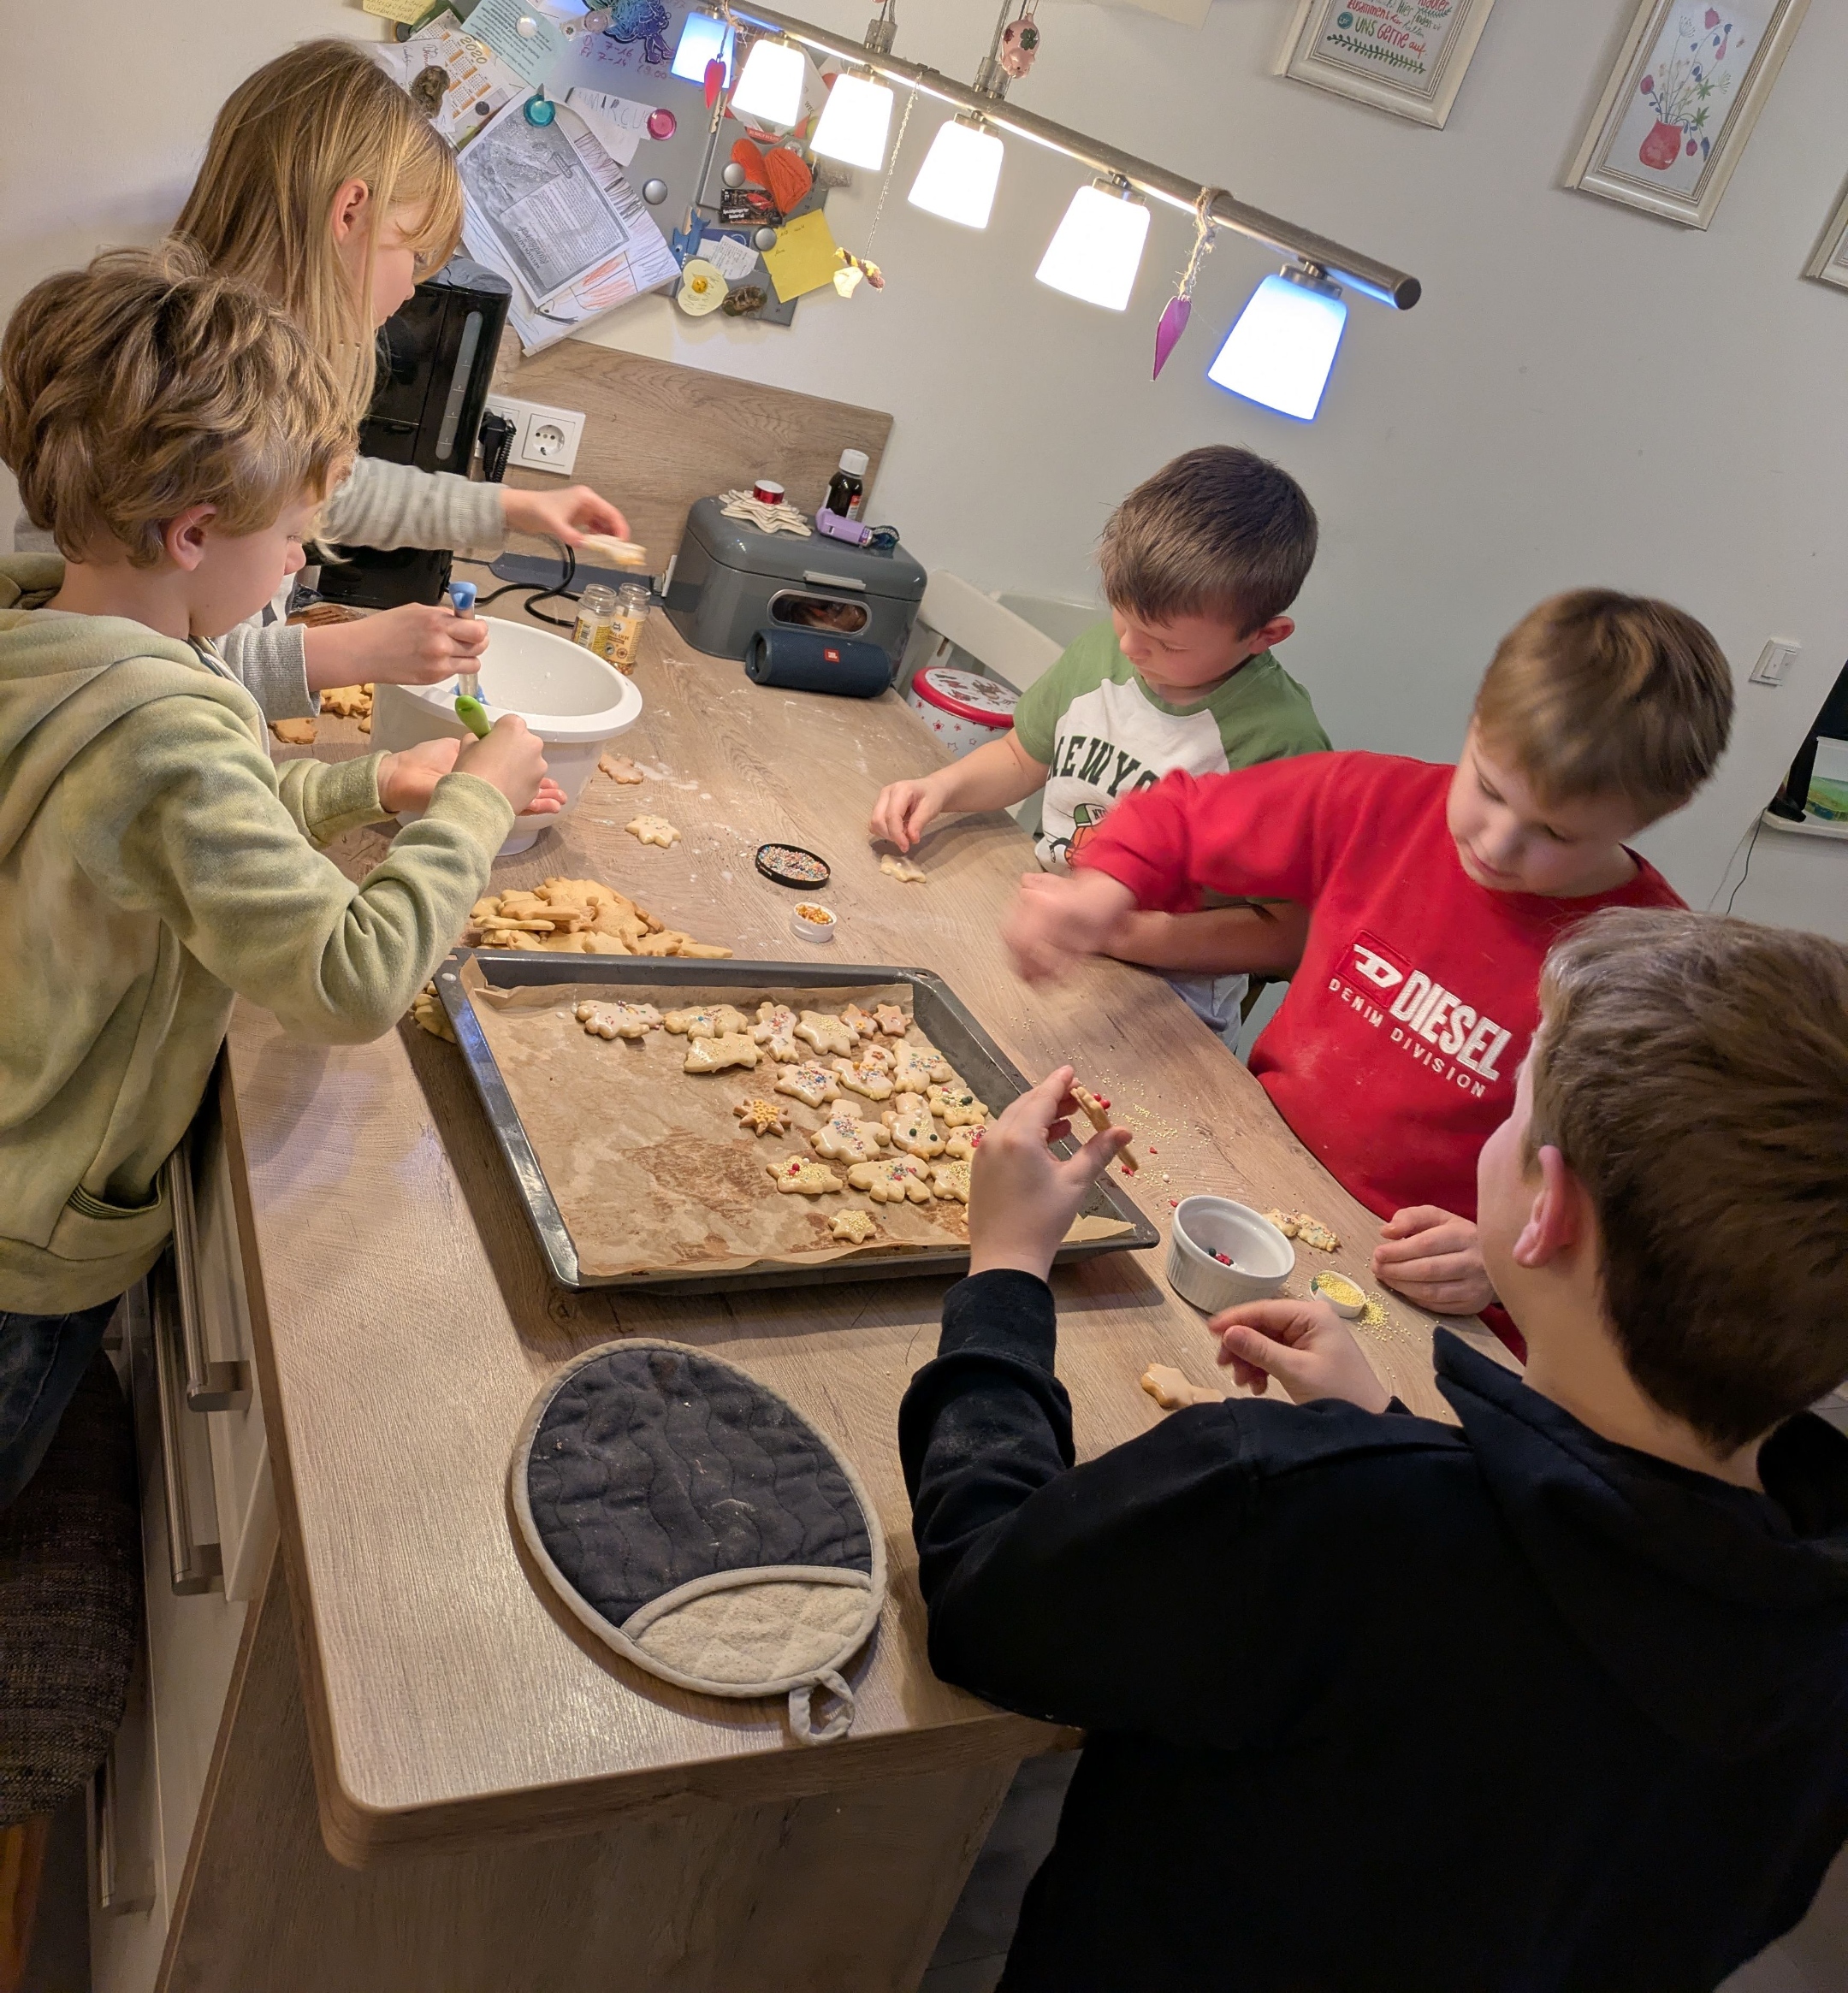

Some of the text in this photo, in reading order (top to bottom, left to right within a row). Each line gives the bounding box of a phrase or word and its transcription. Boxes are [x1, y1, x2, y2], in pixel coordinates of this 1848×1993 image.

[460, 36, 488, 65] 2020
[1355, 16, 1378, 37] UNS
[1328, 978, 1487, 1098] DENIM DIVISION
[1389, 969, 1513, 1082] DIESEL
